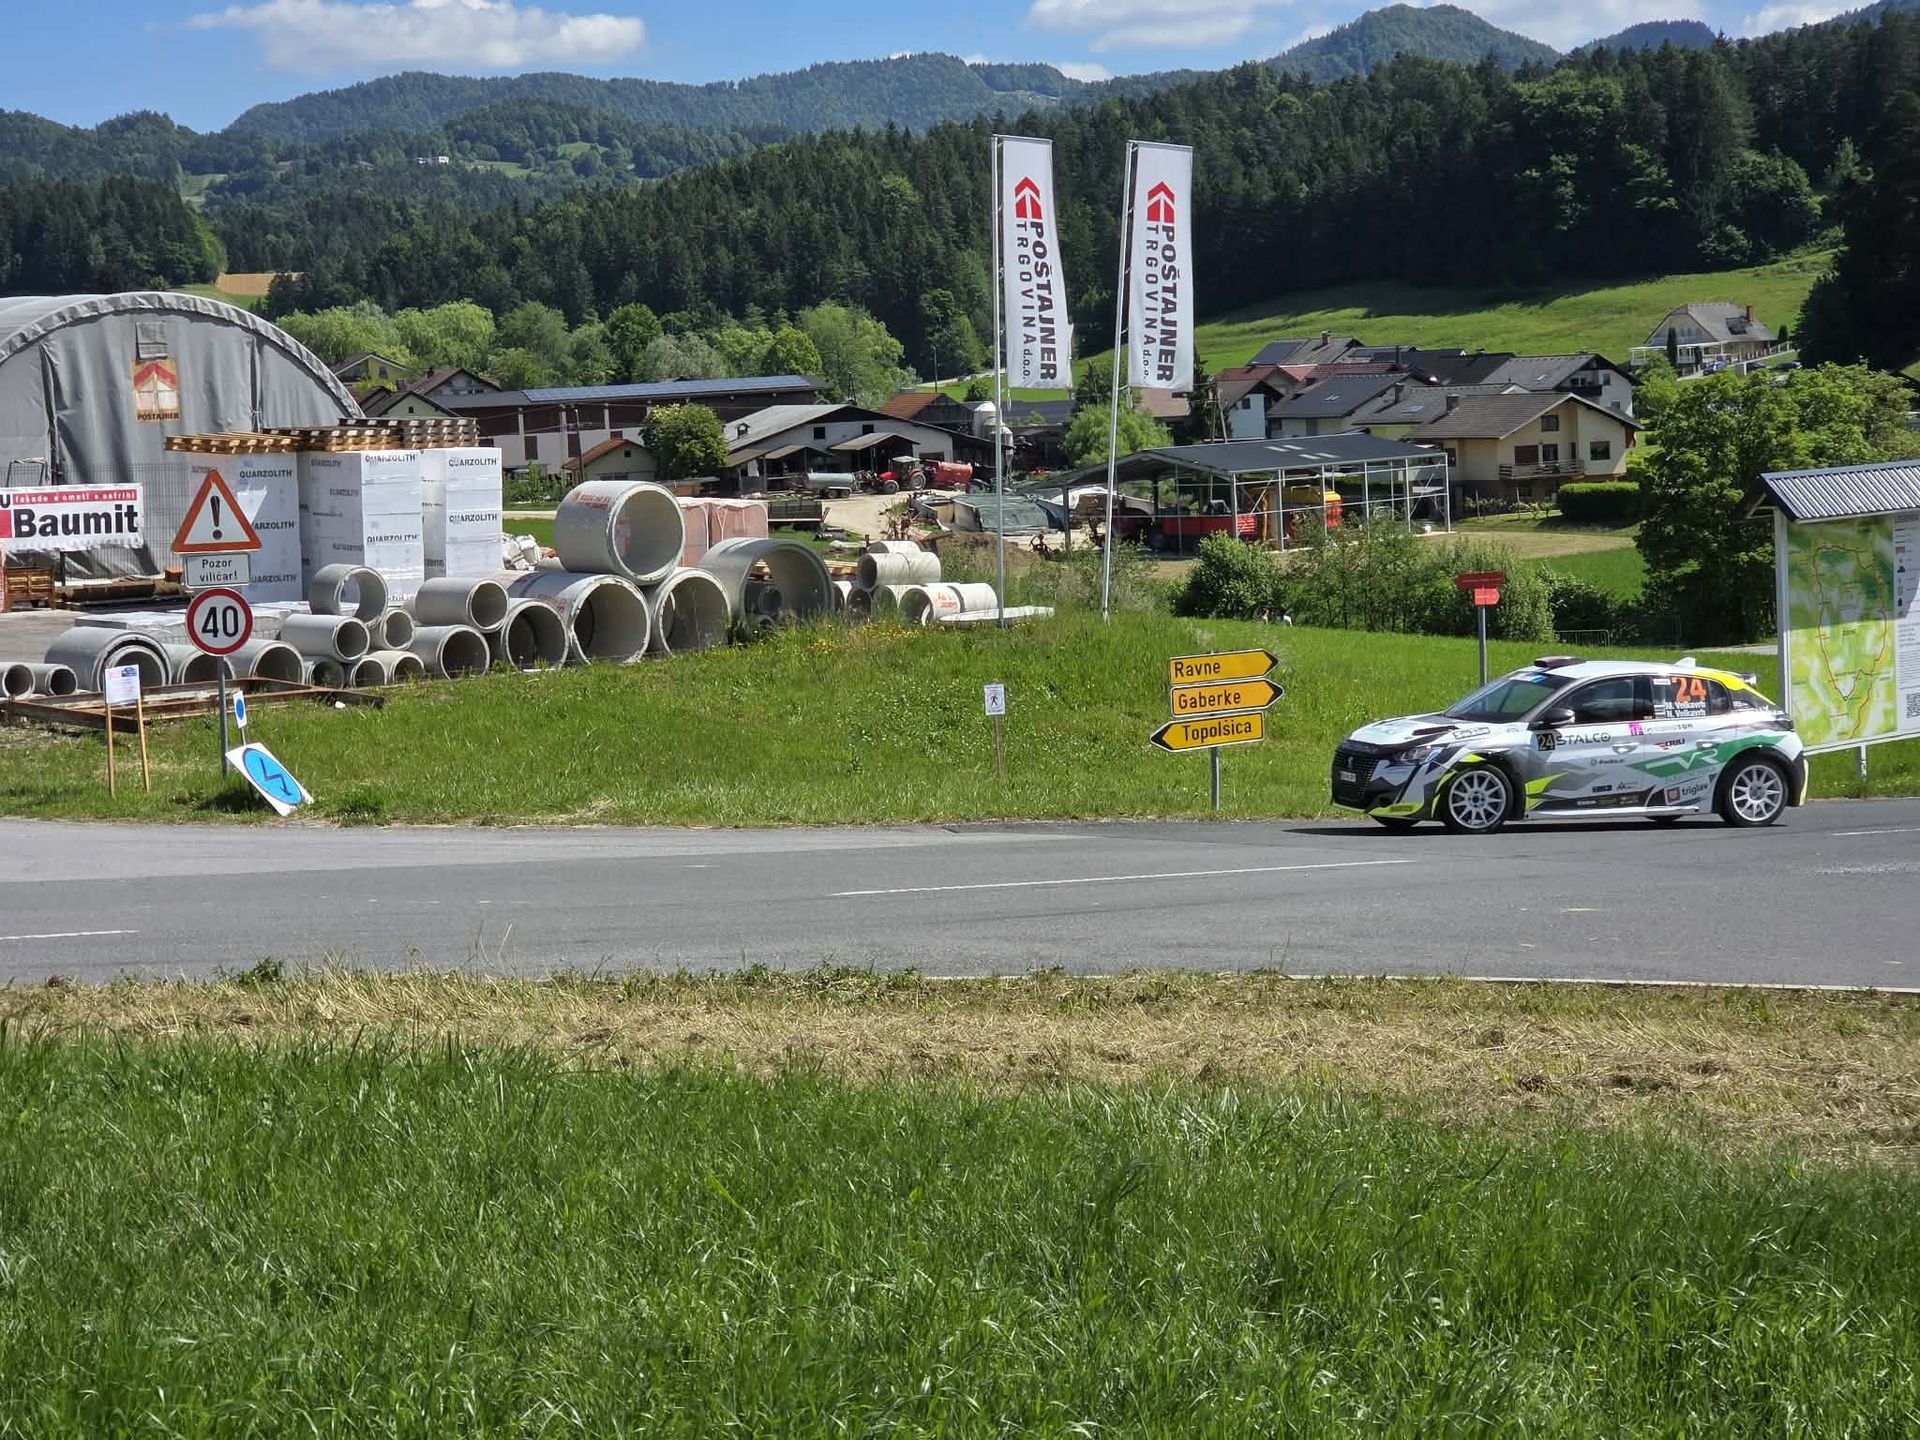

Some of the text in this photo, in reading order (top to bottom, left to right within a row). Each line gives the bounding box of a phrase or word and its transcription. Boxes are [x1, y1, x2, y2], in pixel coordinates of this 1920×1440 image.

[1015, 222, 1037, 344] TRGOVINA
[1143, 225, 1159, 344] TRGOVINA
[1030, 222, 1057, 381] POŠTAJNER
[1156, 225, 1180, 382] POŠTAJNER
[449, 457, 497, 467] QUARZOLITH
[239, 469, 292, 478] QUARZOLITH
[13, 503, 138, 538] Baumit
[449, 513, 497, 523] QUARZOLITH
[252, 522, 295, 531] ARZOLITH
[202, 559, 232, 568] Pozor
[199, 570, 238, 582] viličar!
[252, 574, 296, 584] UARZOLITH
[201, 605, 239, 638] 40
[1174, 661, 1221, 678] Ravne
[1671, 676, 1707, 703] 24
[1178, 690, 1241, 710] Gaberke
[1183, 719, 1252, 743] Topolšica
[1556, 732, 1611, 745] STALCO
[1540, 734, 1554, 749] 24
[1681, 782, 1709, 796] triglav
